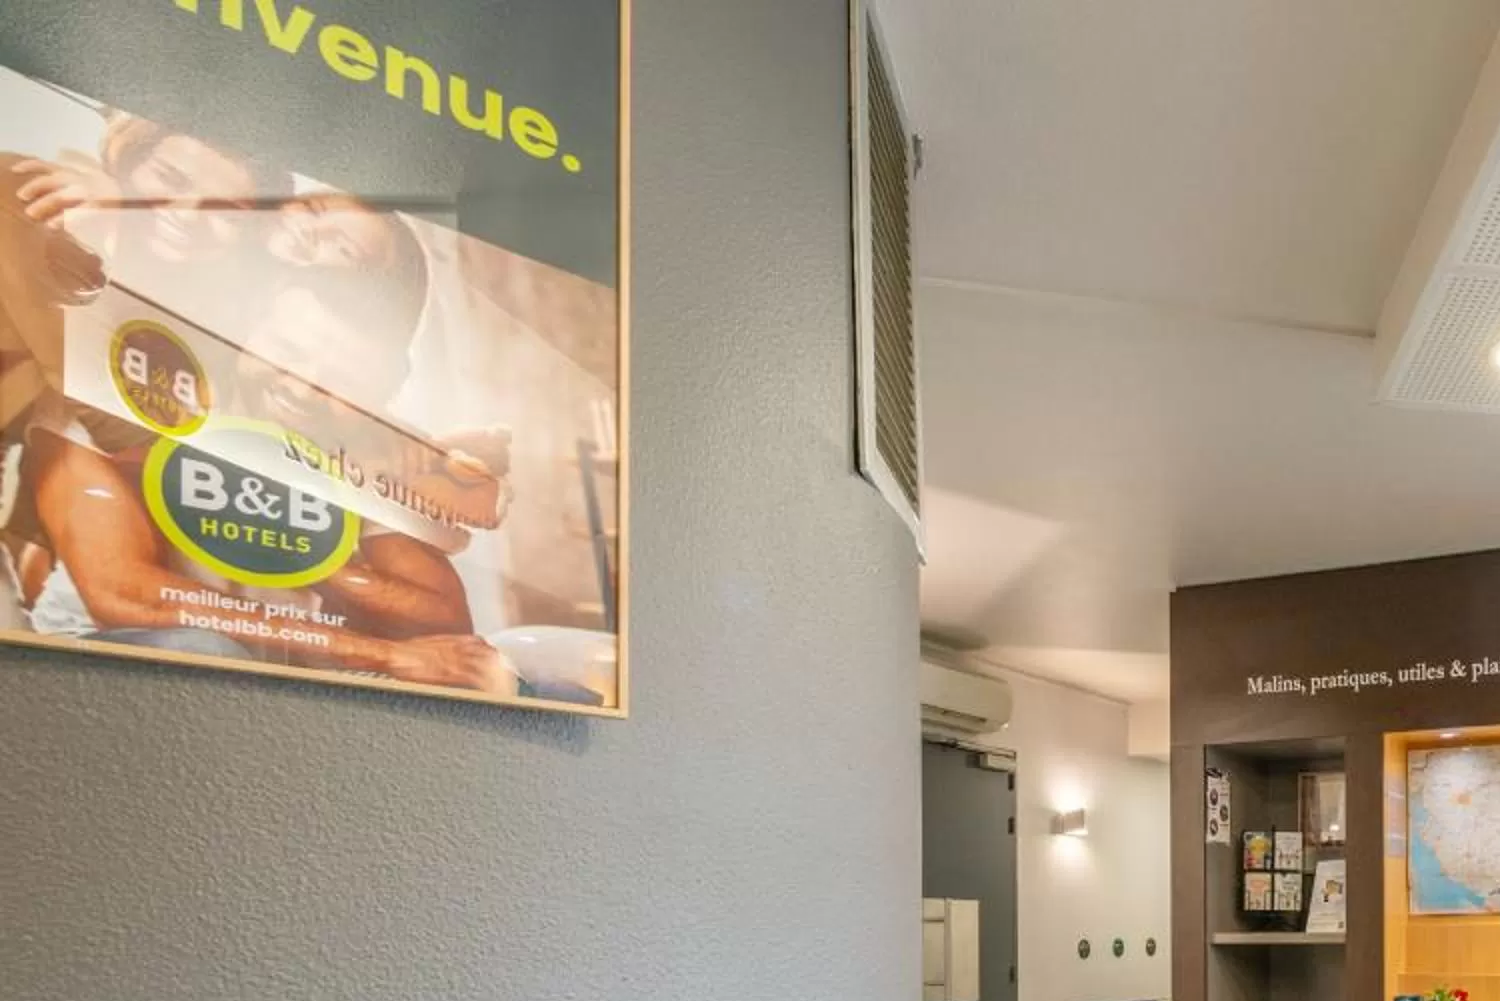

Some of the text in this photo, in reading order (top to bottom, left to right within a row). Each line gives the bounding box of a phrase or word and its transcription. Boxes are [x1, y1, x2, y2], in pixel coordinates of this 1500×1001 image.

[180, 457, 332, 533] B&B
[201, 517, 312, 554] HOTELS
[160, 586, 349, 627] meilleur prix sur
[179, 609, 329, 648] hotelbb.com
[1247, 676, 1306, 696] Malins,
[1310, 668, 1393, 696] pratiques,
[1398, 661, 1445, 683] utiles
[1449, 659, 1467, 677] &
